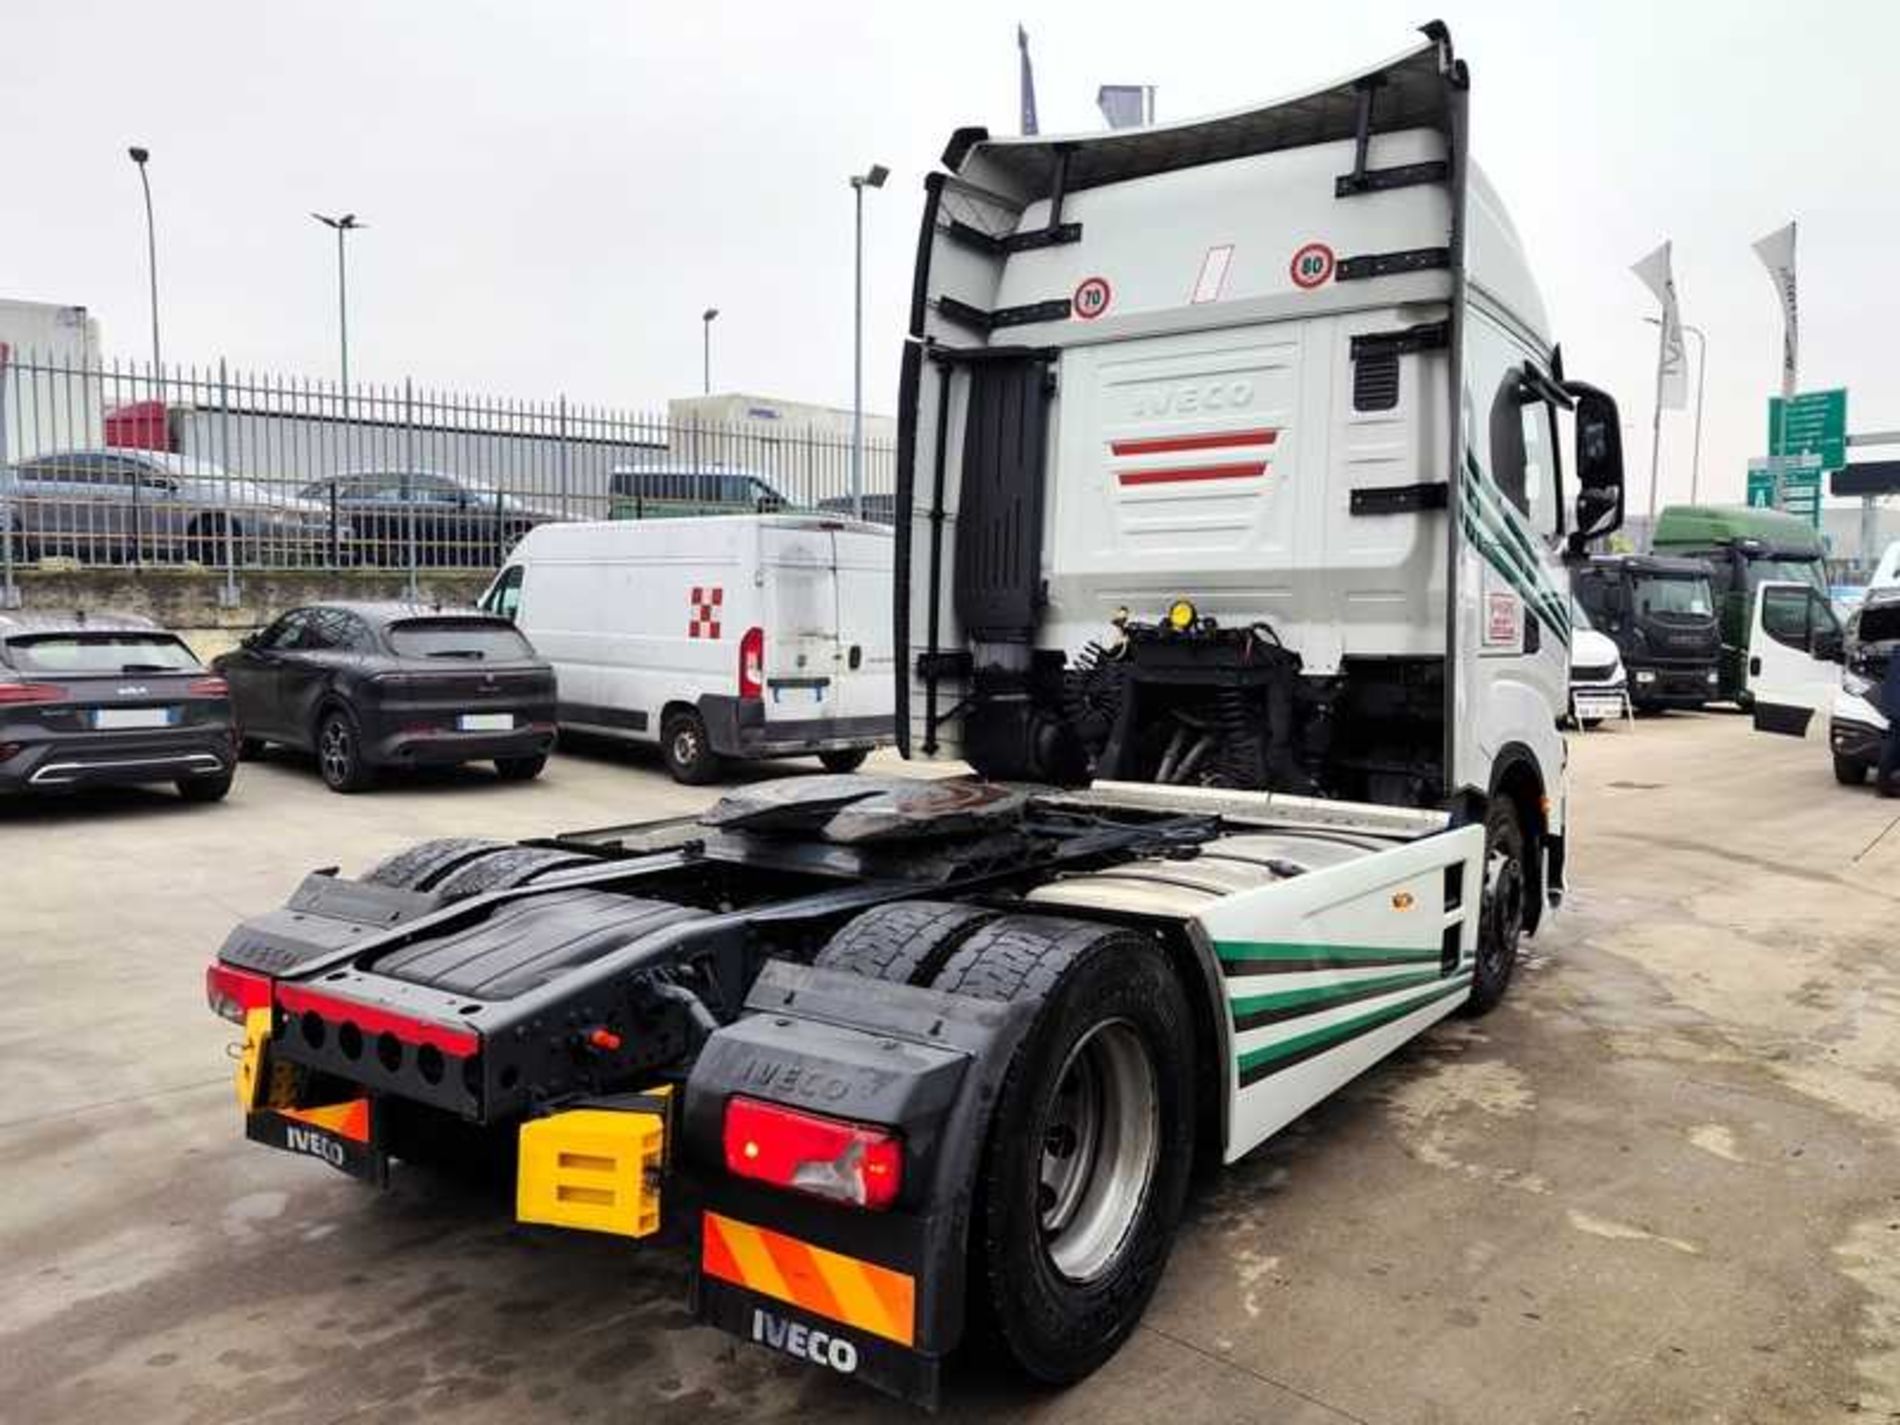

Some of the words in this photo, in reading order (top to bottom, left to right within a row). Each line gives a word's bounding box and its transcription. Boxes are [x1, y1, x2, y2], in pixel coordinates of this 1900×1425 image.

[1302, 256, 1323, 276] 80
[1084, 288, 1101, 306] 70
[1131, 379, 1255, 417] IVECO
[743, 1058, 851, 1101] IVECO
[286, 1125, 343, 1166] IVECO
[752, 1308, 858, 1374] IVECO
